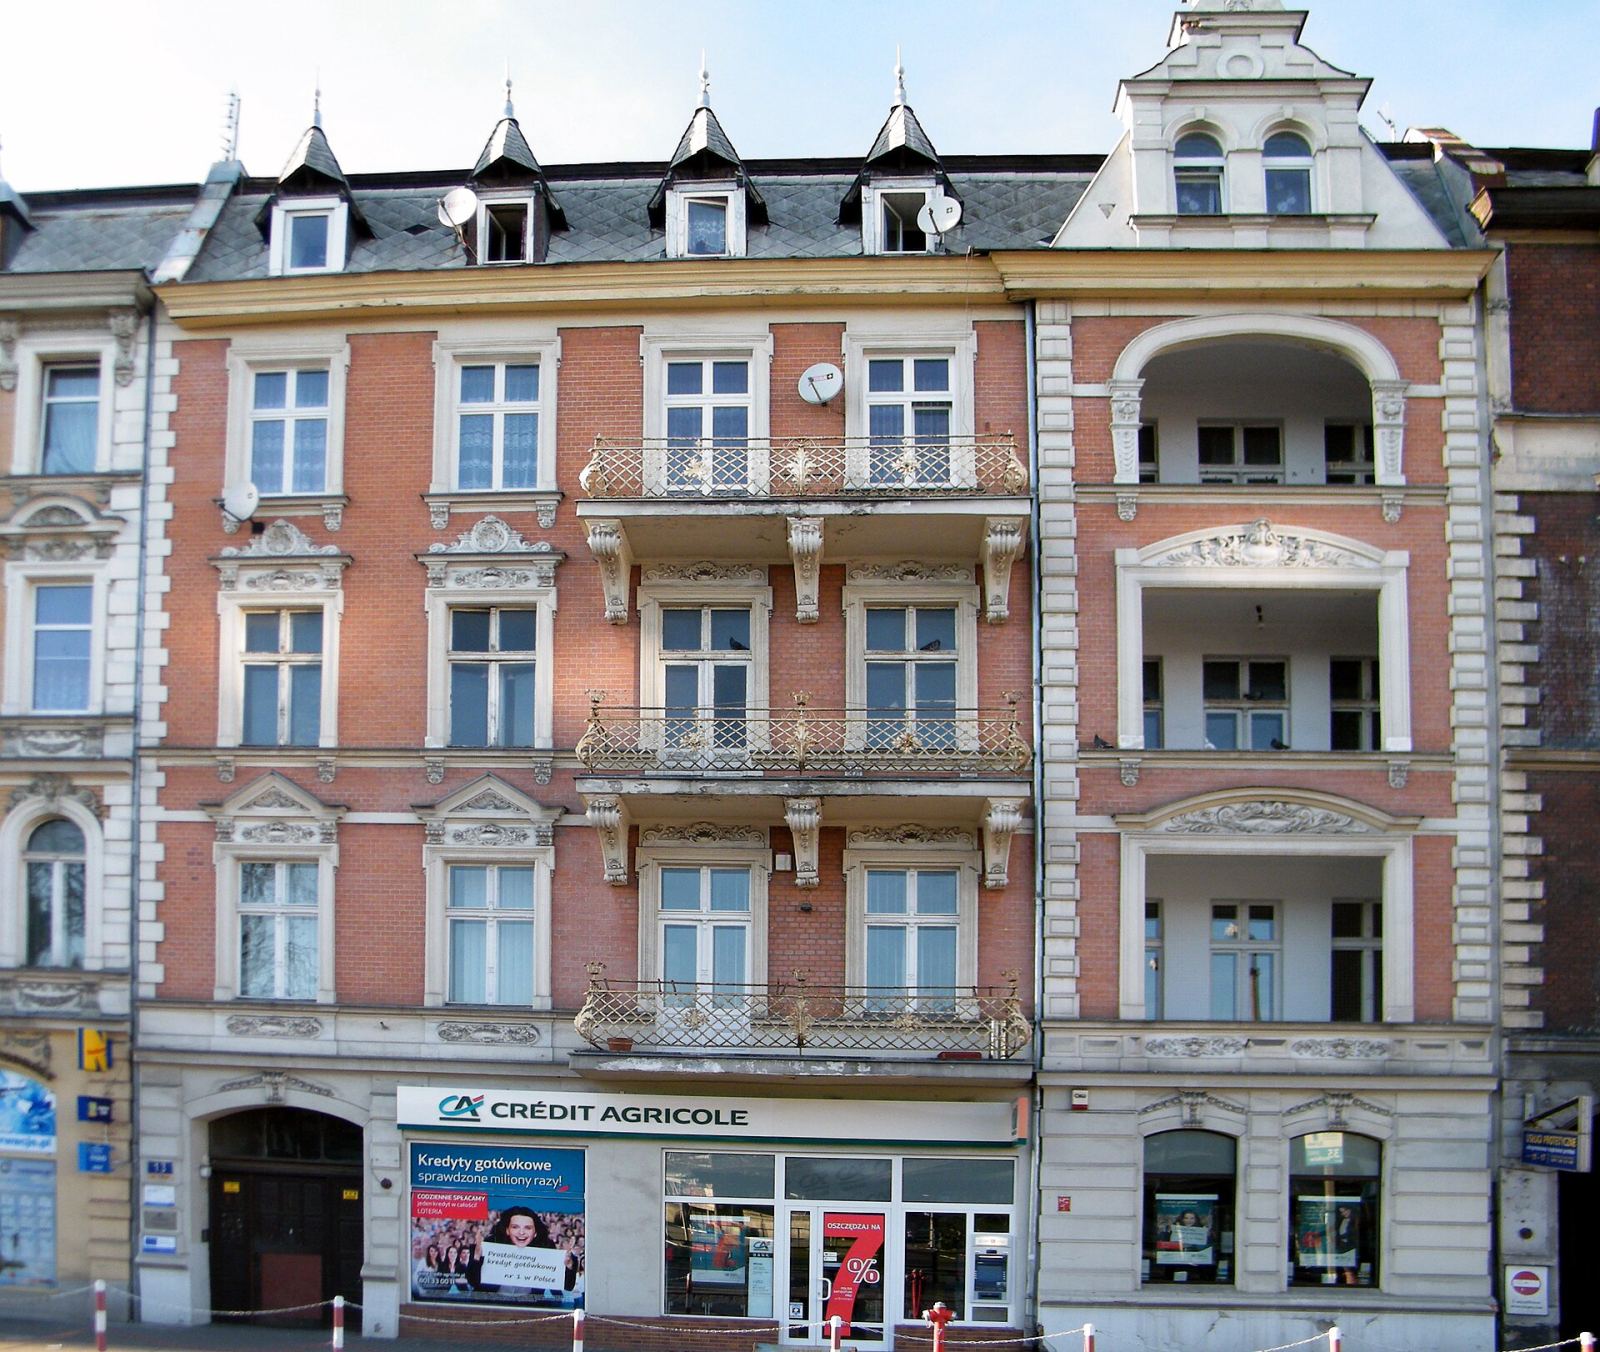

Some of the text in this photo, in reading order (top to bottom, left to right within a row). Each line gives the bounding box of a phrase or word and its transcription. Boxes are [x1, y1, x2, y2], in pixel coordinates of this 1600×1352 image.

[490, 1101, 749, 1127] CRÉDIT AGRICOLE
[418, 1153, 552, 1172] Kredyty gotówkowe
[418, 1172, 562, 1189] sprawdzone miliony razy!
[417, 1193, 486, 1202] CODZIENNIE SPŁACAMY
[432, 1201, 451, 1209] kredyt
[827, 1222, 869, 1231] OSZCZĘDZAJ
[487, 1250, 537, 1262] Prostoliczony
[487, 1258, 557, 1272] kredyt gotówkowy
[533, 1275, 556, 1283] Polsce
